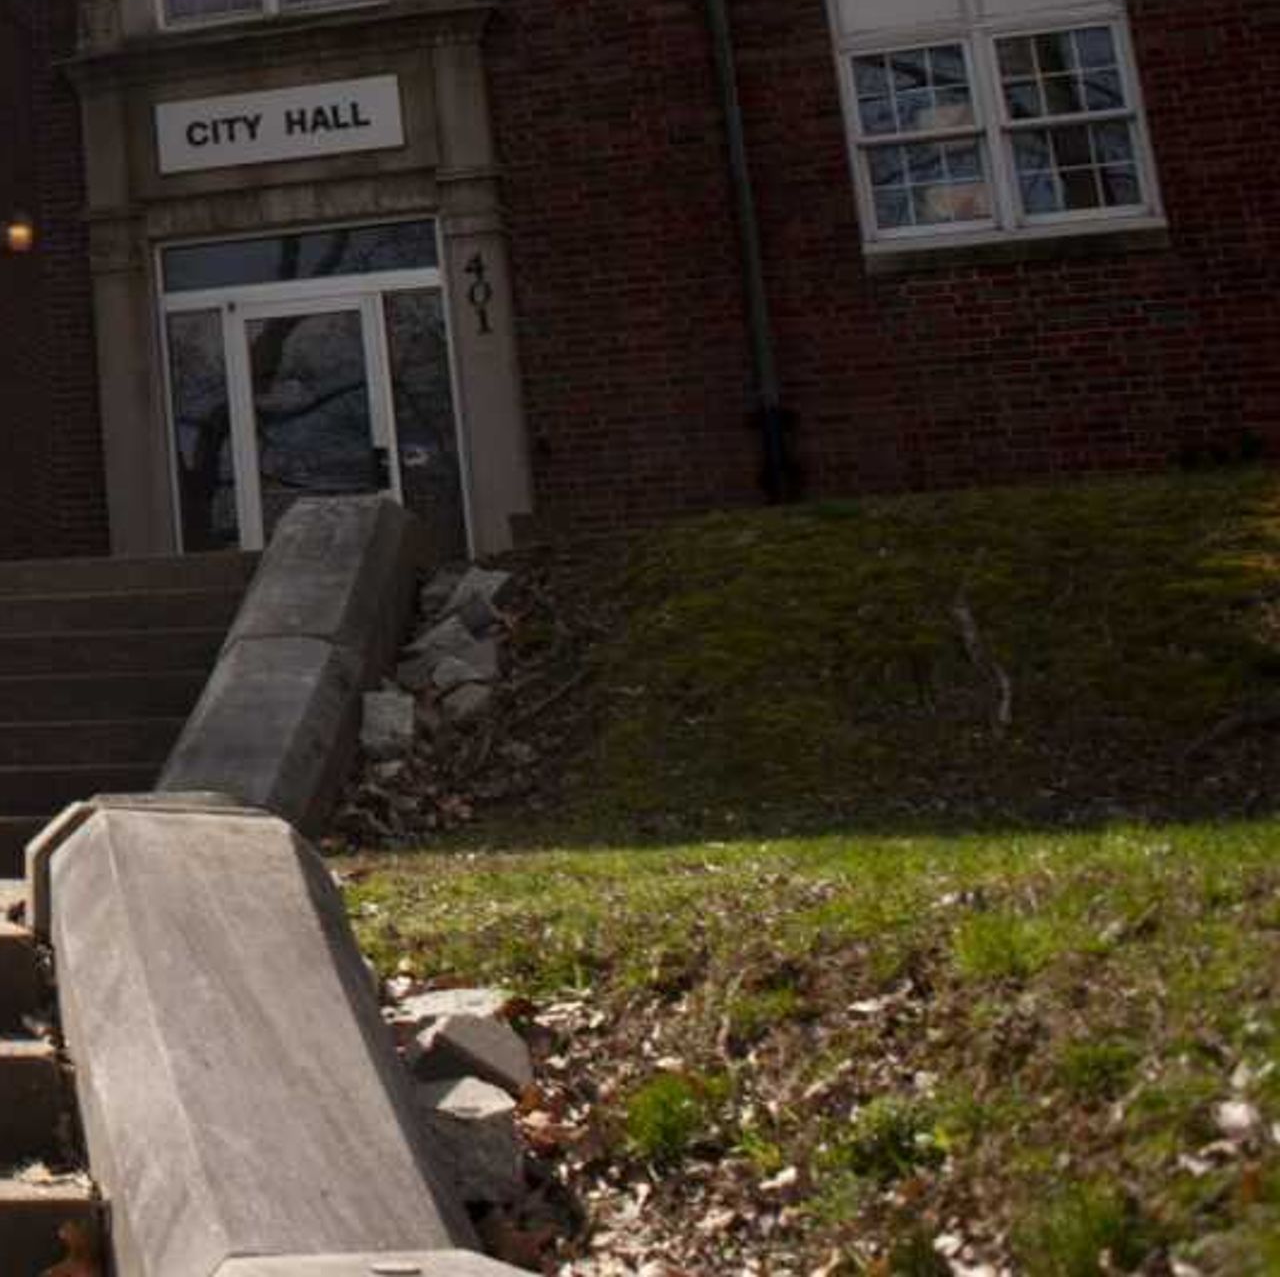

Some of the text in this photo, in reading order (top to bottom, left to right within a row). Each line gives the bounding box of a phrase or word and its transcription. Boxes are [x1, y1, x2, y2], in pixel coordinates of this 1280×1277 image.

[185, 101, 371, 147] CITY HALL
[464, 252, 493, 335] 401
